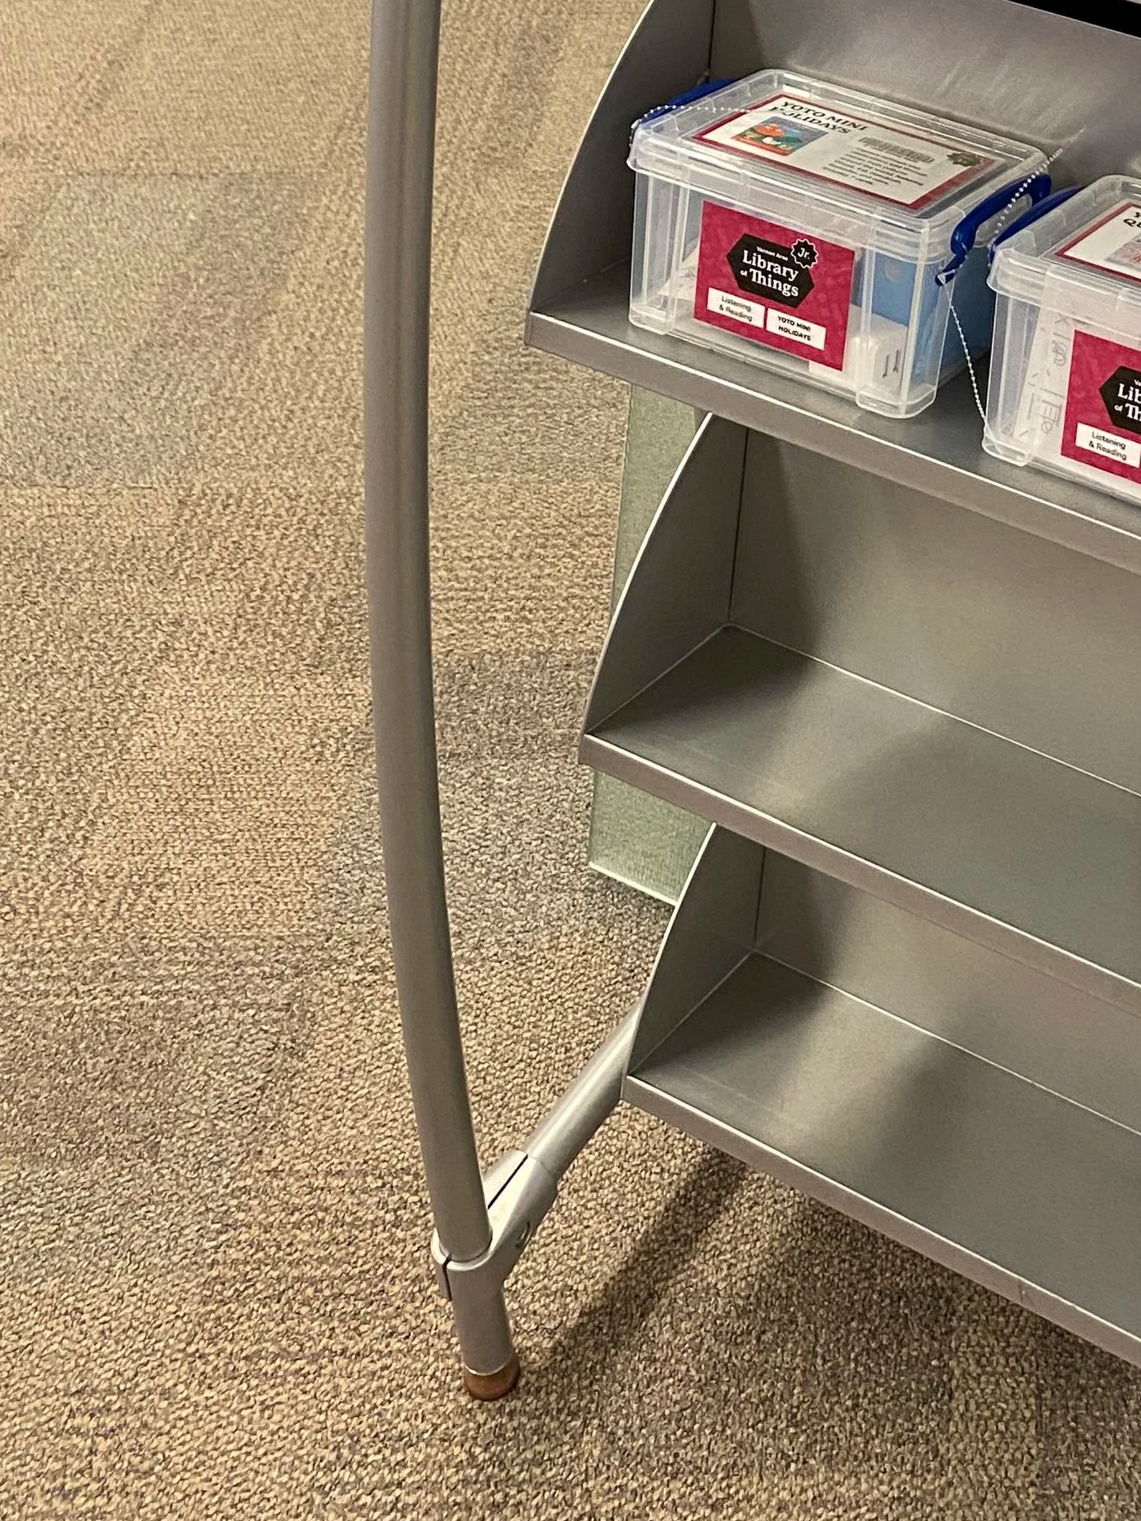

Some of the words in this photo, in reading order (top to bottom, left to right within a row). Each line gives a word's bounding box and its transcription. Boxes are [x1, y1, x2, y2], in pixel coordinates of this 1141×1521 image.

[781, 101, 826, 118] YOTO
[828, 115, 868, 131] MINI
[797, 247, 811, 260] Jr.
[742, 250, 799, 282] Library
[749, 269, 799, 297] Things
[721, 296, 752, 312] Listening
[725, 306, 753, 322] Reading
[777, 316, 795, 326] YOTO
[778, 325, 811, 341] HOLIDAYS
[1091, 431, 1126, 450] Listening
[1096, 443, 1127, 461] Reading
